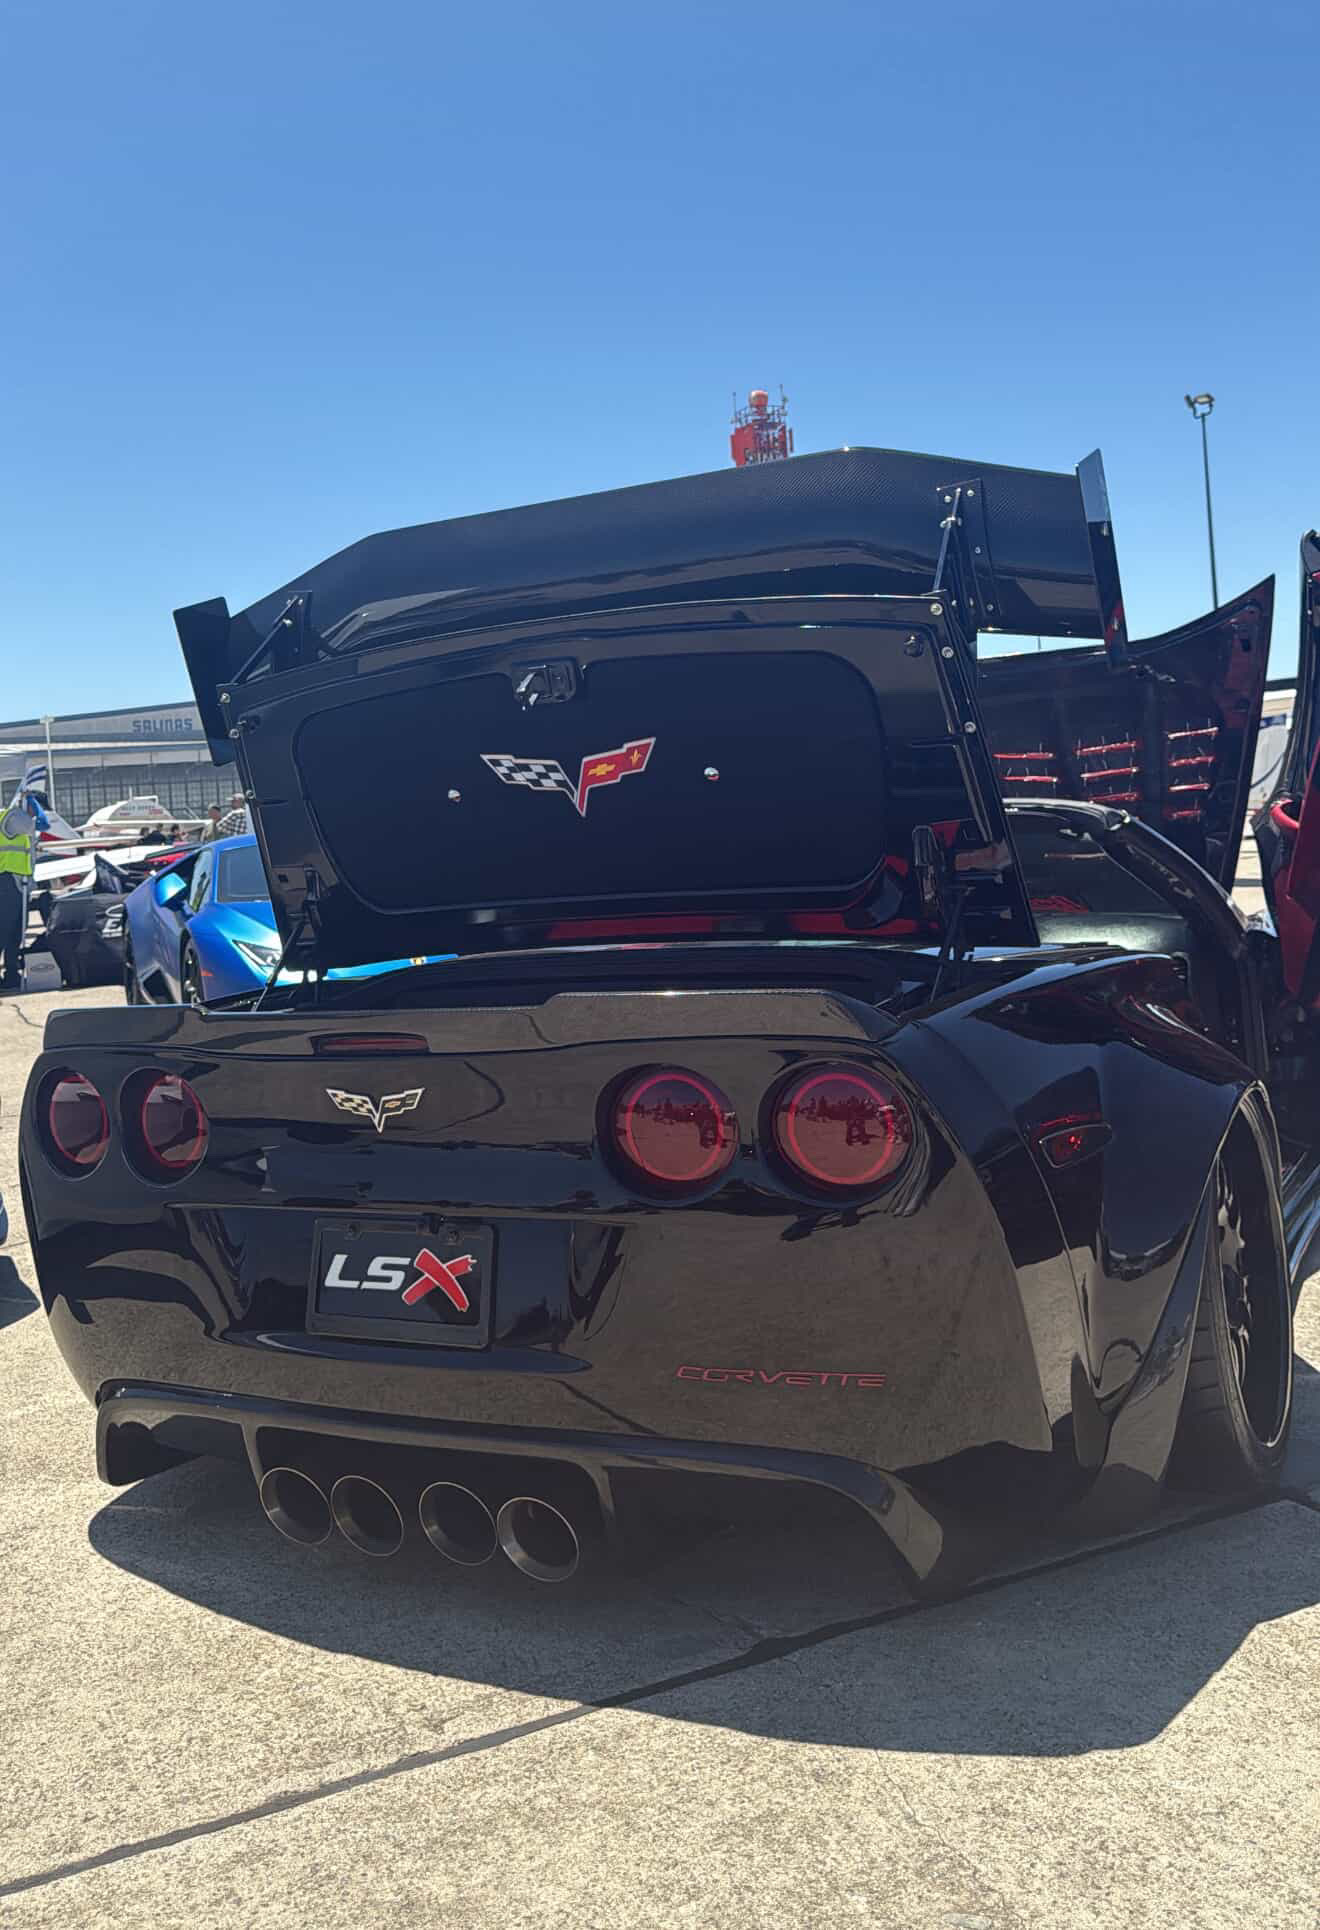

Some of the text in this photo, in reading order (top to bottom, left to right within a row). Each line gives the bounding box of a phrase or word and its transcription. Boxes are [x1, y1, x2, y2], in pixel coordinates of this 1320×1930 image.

[132, 718, 193, 733] SALINAS
[324, 1248, 478, 1312] LSX
[677, 1365, 888, 1387] CORVETTE
